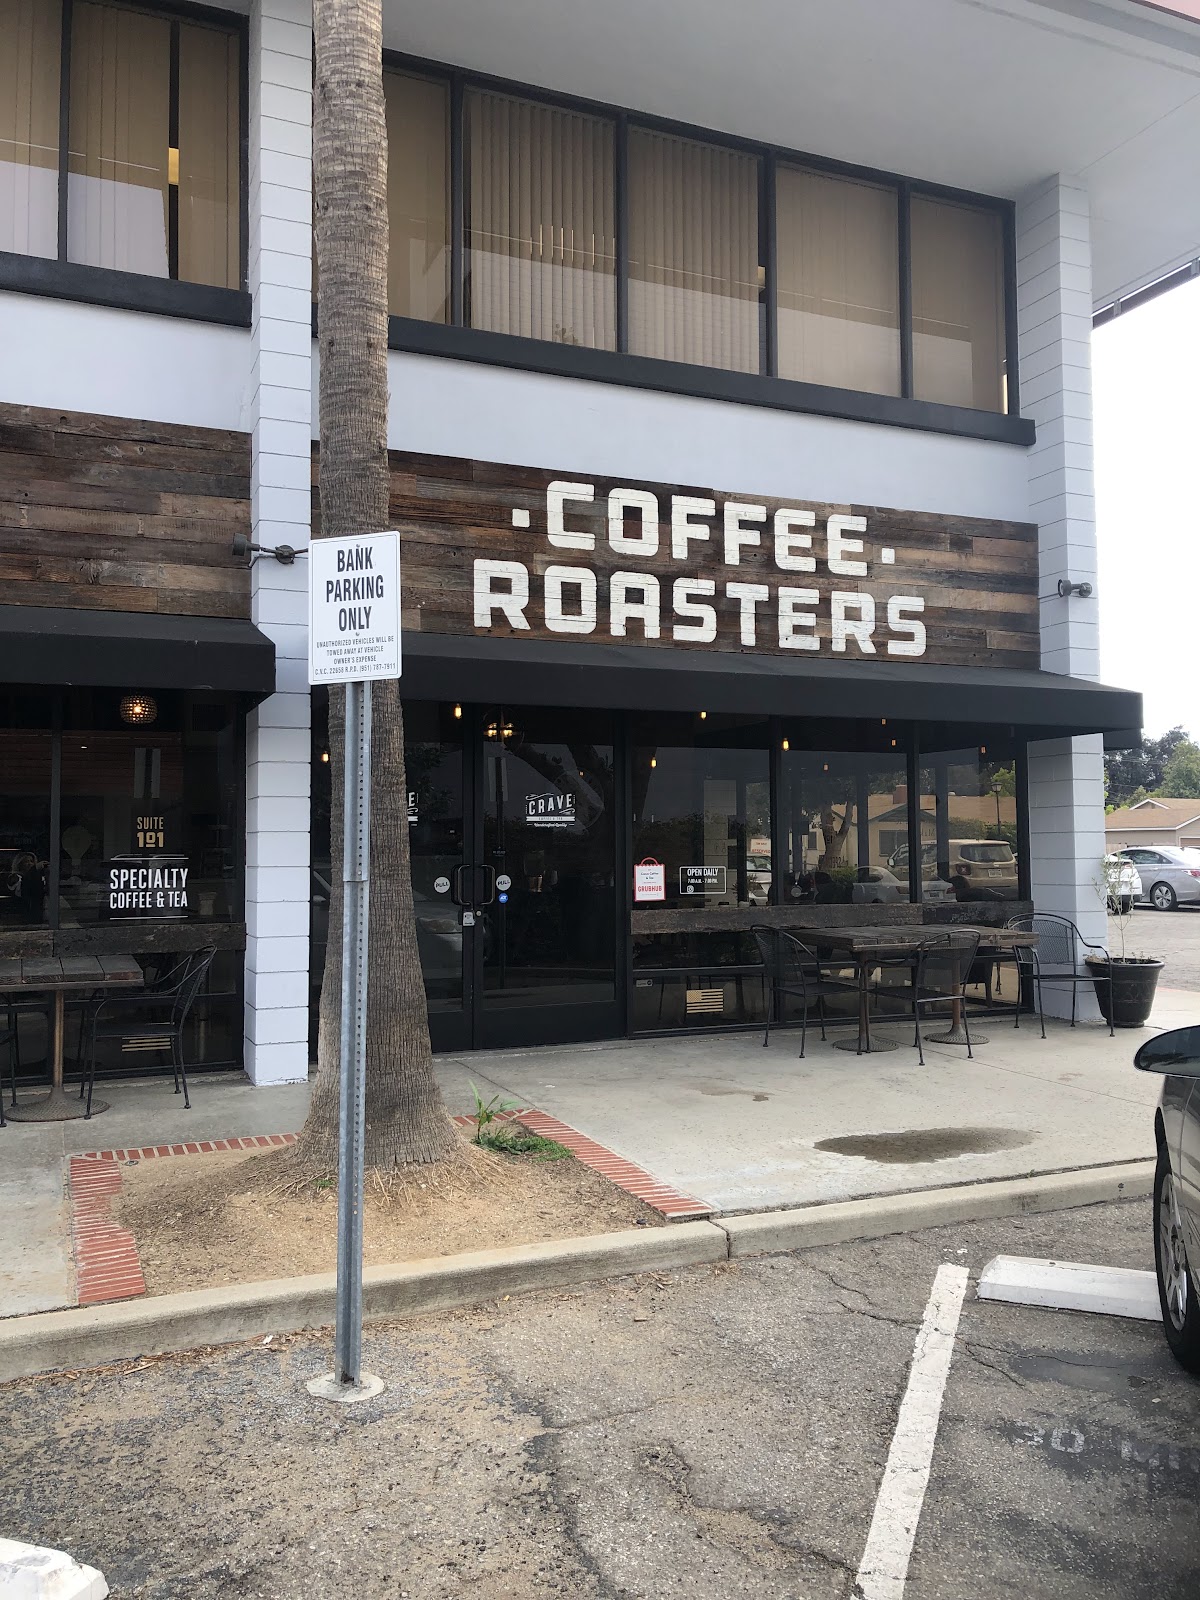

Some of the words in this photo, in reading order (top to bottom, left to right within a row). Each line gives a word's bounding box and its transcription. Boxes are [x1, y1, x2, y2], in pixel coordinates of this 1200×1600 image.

[546, 480, 868, 577] COFFEE
[337, 546, 373, 572] BANK
[326, 574, 384, 603] PARKING
[473, 558, 927, 657] ROASTERS
[338, 606, 372, 632] ONLY
[316, 639, 352, 649] UNAUTHORIZED
[352, 637, 375, 645] VEHICLES
[326, 648, 343, 656] TOWED
[343, 647, 357, 655] AWAY
[364, 645, 384, 653] VEHICLE
[333, 656, 355, 665] OWNER'S
[355, 655, 377, 663] EXPENSE
[528, 793, 573, 816] CRAVE
[137, 816, 164, 830] SUITE
[136, 831, 164, 848] 101
[109, 868, 189, 890] SPECIALTY
[687, 868, 702, 877] OPEN
[703, 868, 718, 877] DAILY
[637, 885, 662, 893] GRUBHUB
[109, 891, 152, 909] COFFEE
[156, 891, 165, 908] &
[167, 890, 188, 908] TEA
